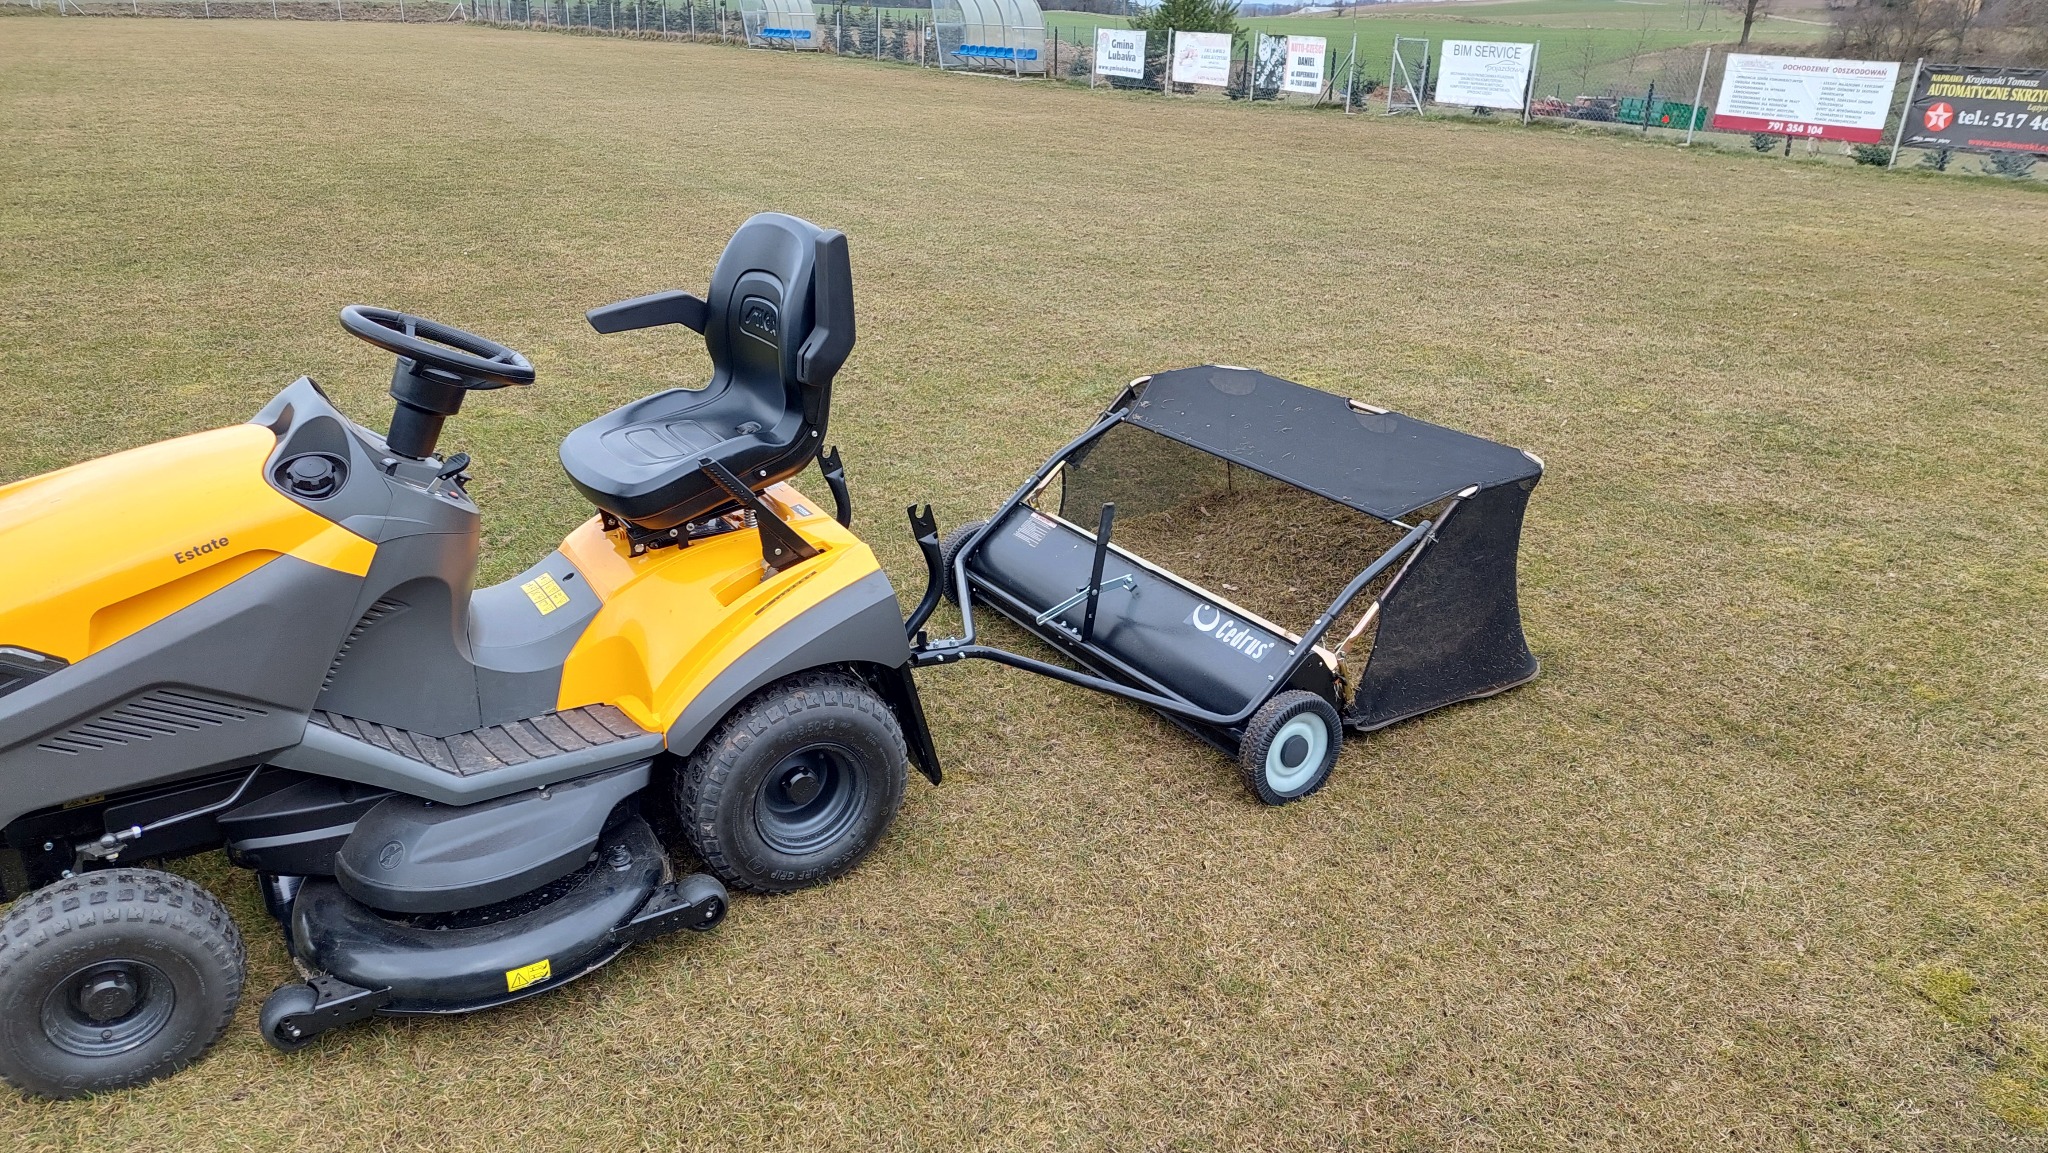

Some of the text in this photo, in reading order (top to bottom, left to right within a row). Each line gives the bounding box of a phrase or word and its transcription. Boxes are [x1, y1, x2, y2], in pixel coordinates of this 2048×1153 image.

[1111, 39, 1134, 50] Gmina
[1107, 50, 1136, 62] Lubawa
[1453, 44, 1522, 59] BIM SERVICE
[1297, 56, 1315, 67] DANIEL
[1782, 64, 1830, 73] DOCHODZENIE
[1832, 67, 1888, 76] ODSZKODOWAŃ
[1931, 74, 2040, 87] NAPRAWA Krajewski Tomasz
[1927, 84, 2010, 100] AUTOMATYCZNE
[1957, 110, 1990, 126] tel.:
[1992, 112, 2029, 129] 517
[1767, 121, 1823, 135] 791 354 104
[173, 537, 230, 565] Estate
[1215, 620, 1268, 659] Cedrus
[770, 869, 795, 880] GRIP
